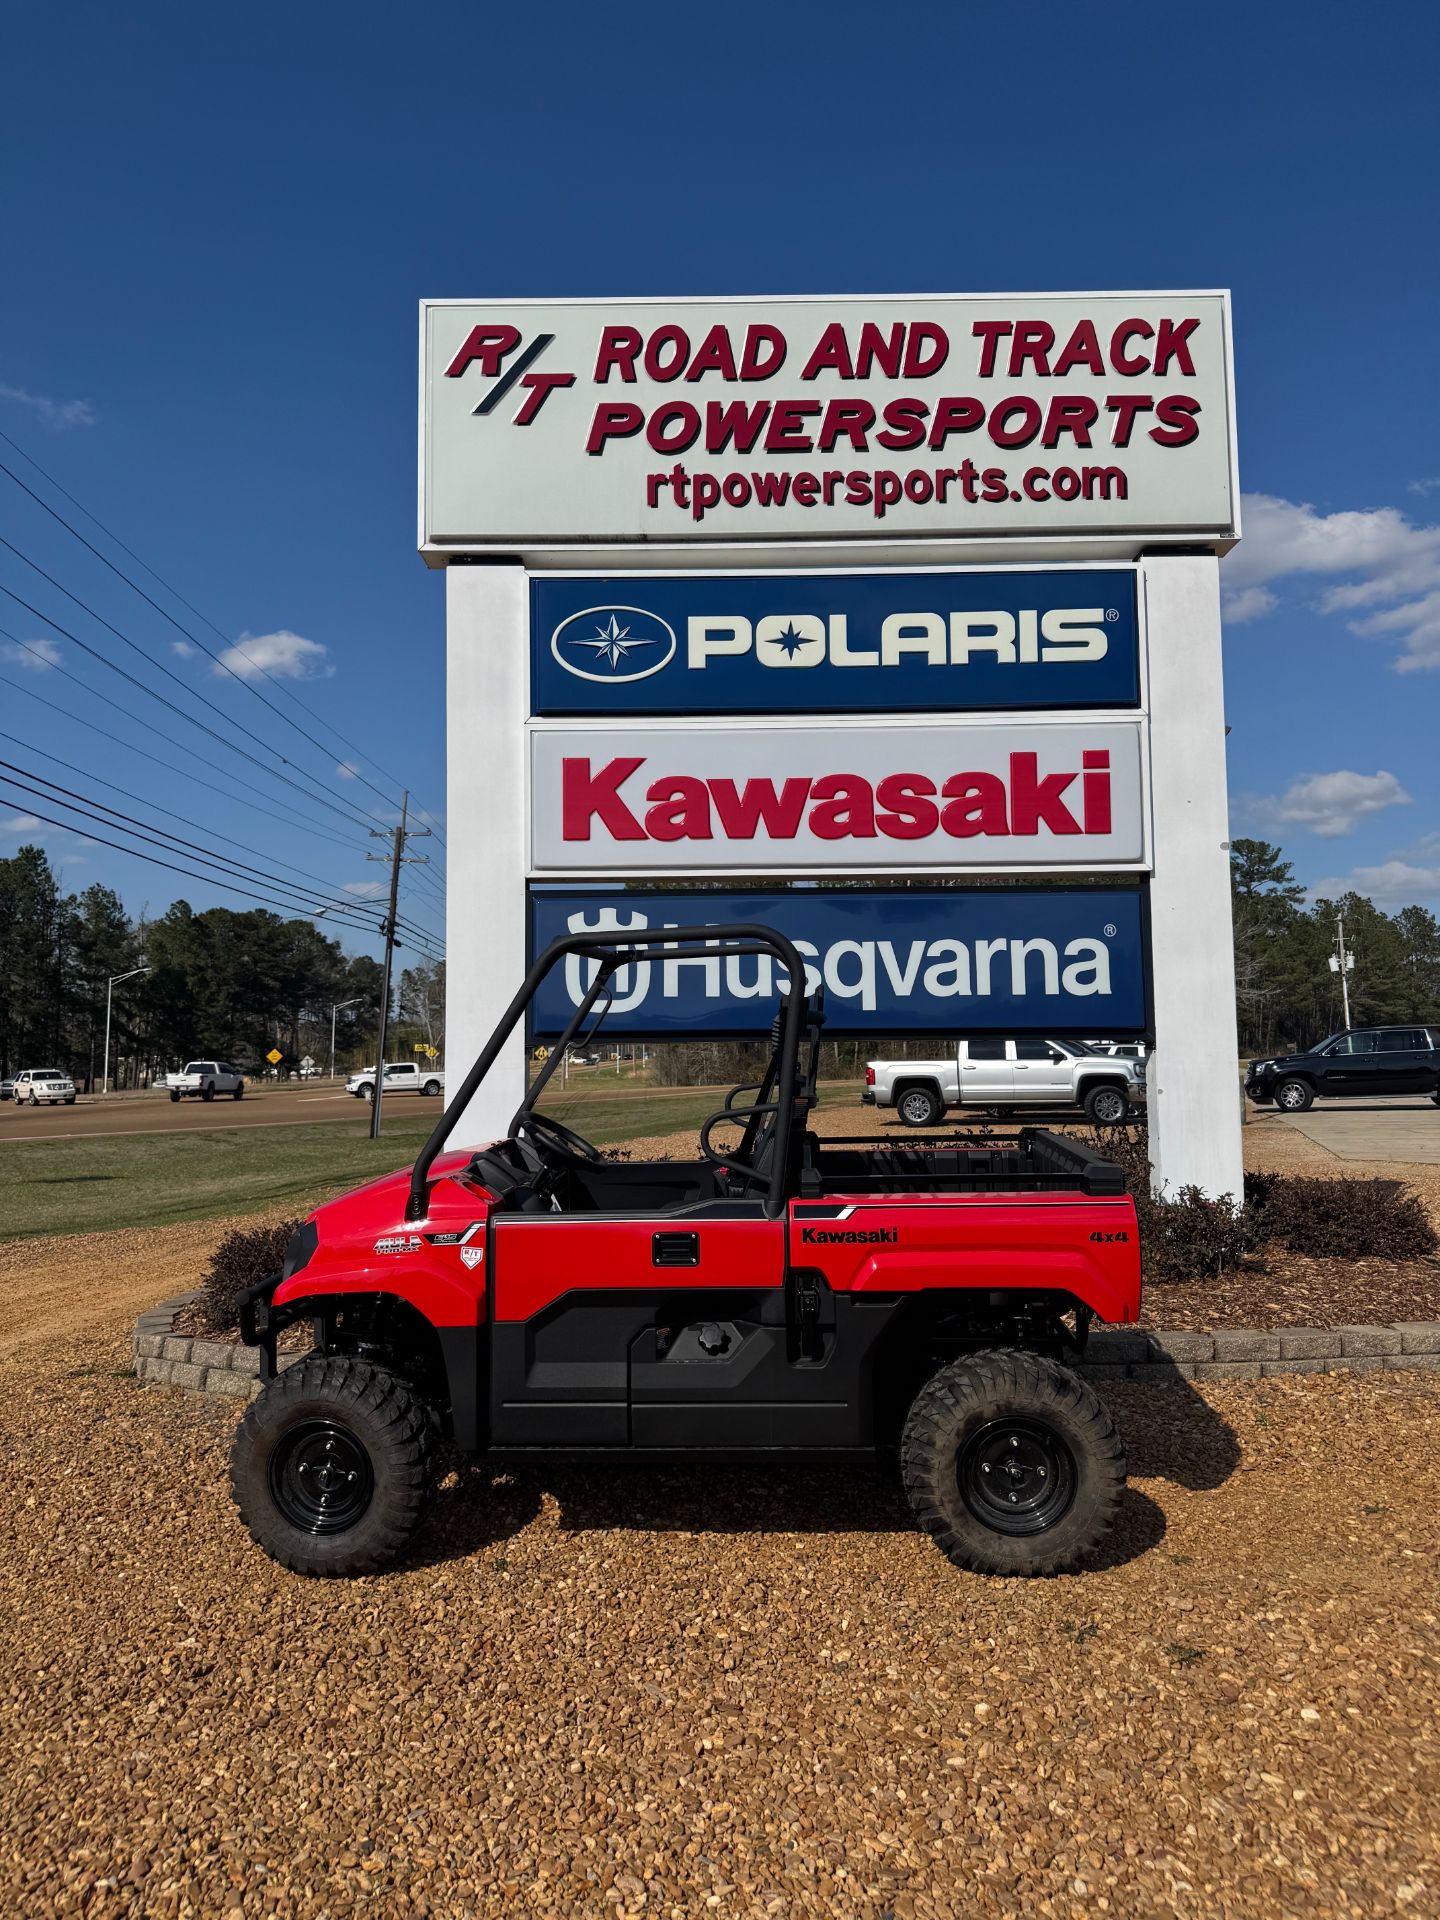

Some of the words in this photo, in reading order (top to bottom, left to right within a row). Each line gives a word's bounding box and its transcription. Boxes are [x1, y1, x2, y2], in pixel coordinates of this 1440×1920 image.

[594, 324, 787, 383] ROAD
[801, 322, 949, 380] AND
[972, 318, 1200, 377] TRACK
[586, 395, 1201, 455] POWERSPORTS
[647, 459, 1127, 521] rtpowersports.com
[688, 608, 1108, 669] POLARIS
[563, 750, 1112, 841] Kawasaki
[374, 1236, 424, 1249] MULE
[802, 1227, 898, 1243] Kawasaki
[1089, 1231, 1129, 1243] 4x4
